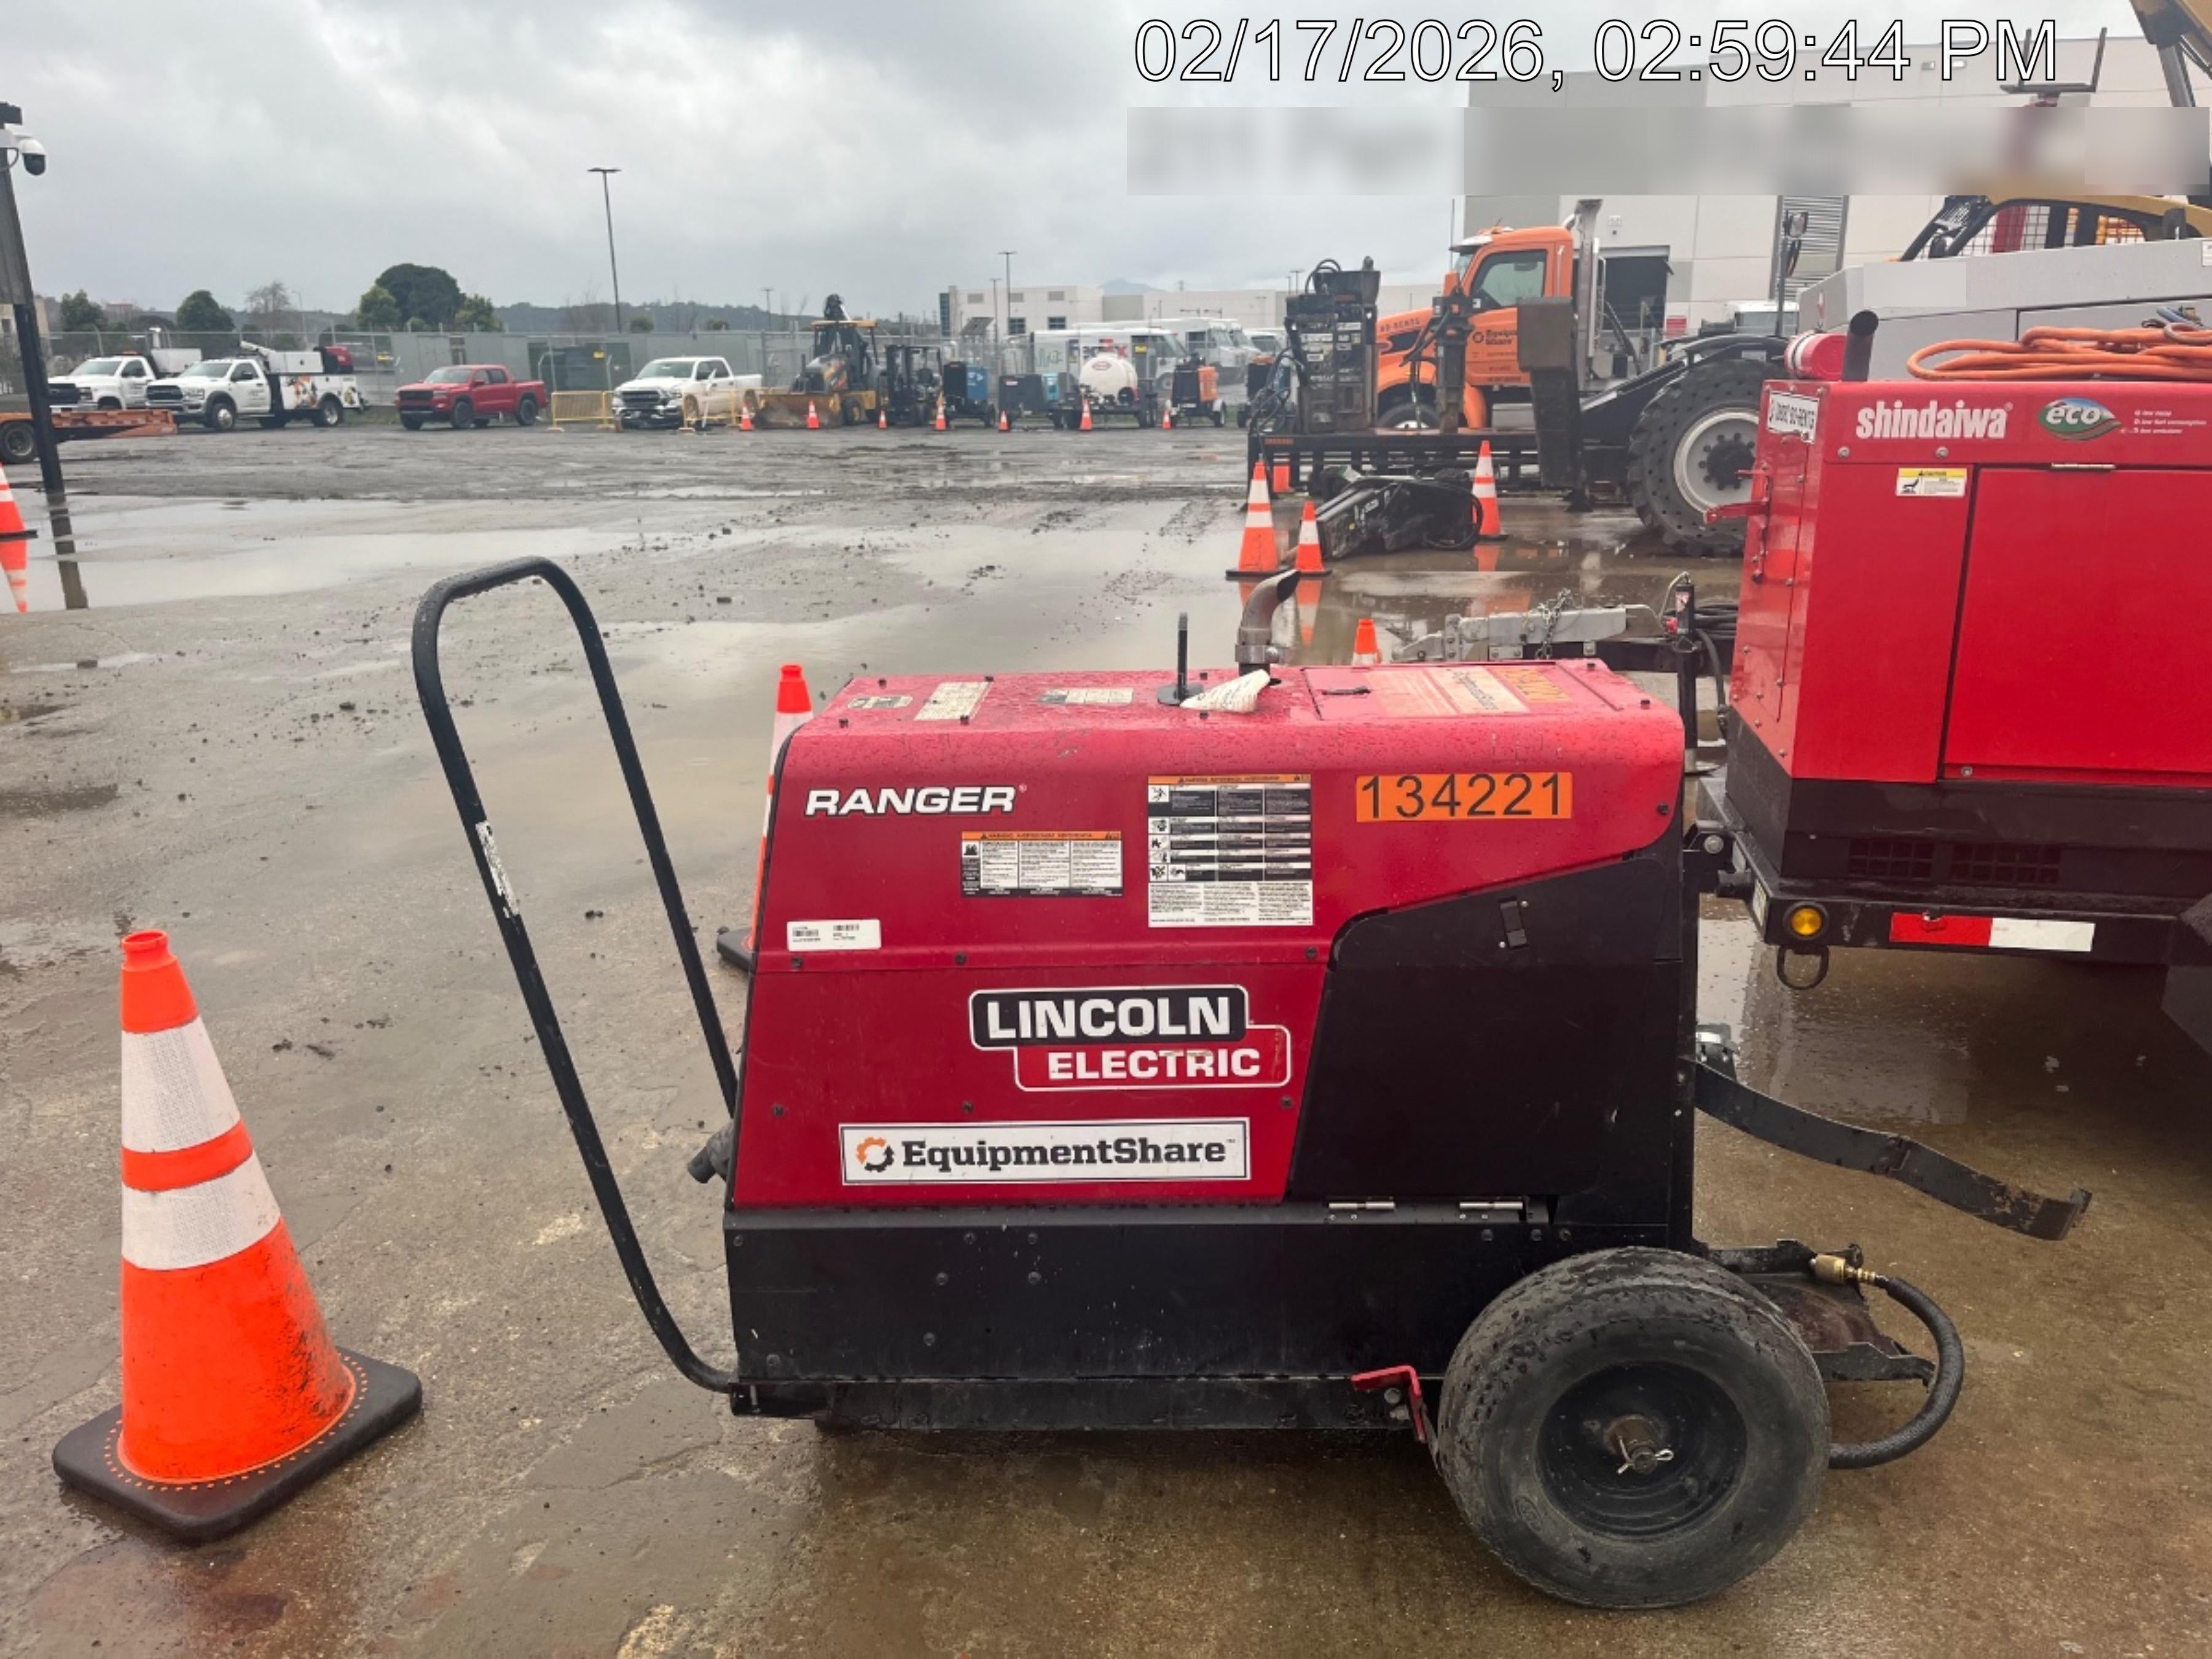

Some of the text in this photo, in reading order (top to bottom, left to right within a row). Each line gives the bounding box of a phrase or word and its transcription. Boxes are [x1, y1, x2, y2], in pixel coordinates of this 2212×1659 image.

[1856, 400, 2007, 439] shindaiwa
[805, 786, 1016, 816] RANGER
[1362, 773, 1559, 818] 134221
[987, 997, 1230, 1038] LINCOLN
[1048, 1048, 1261, 1080] ELECTRIC
[901, 1138, 1226, 1172] EquipmentShare
